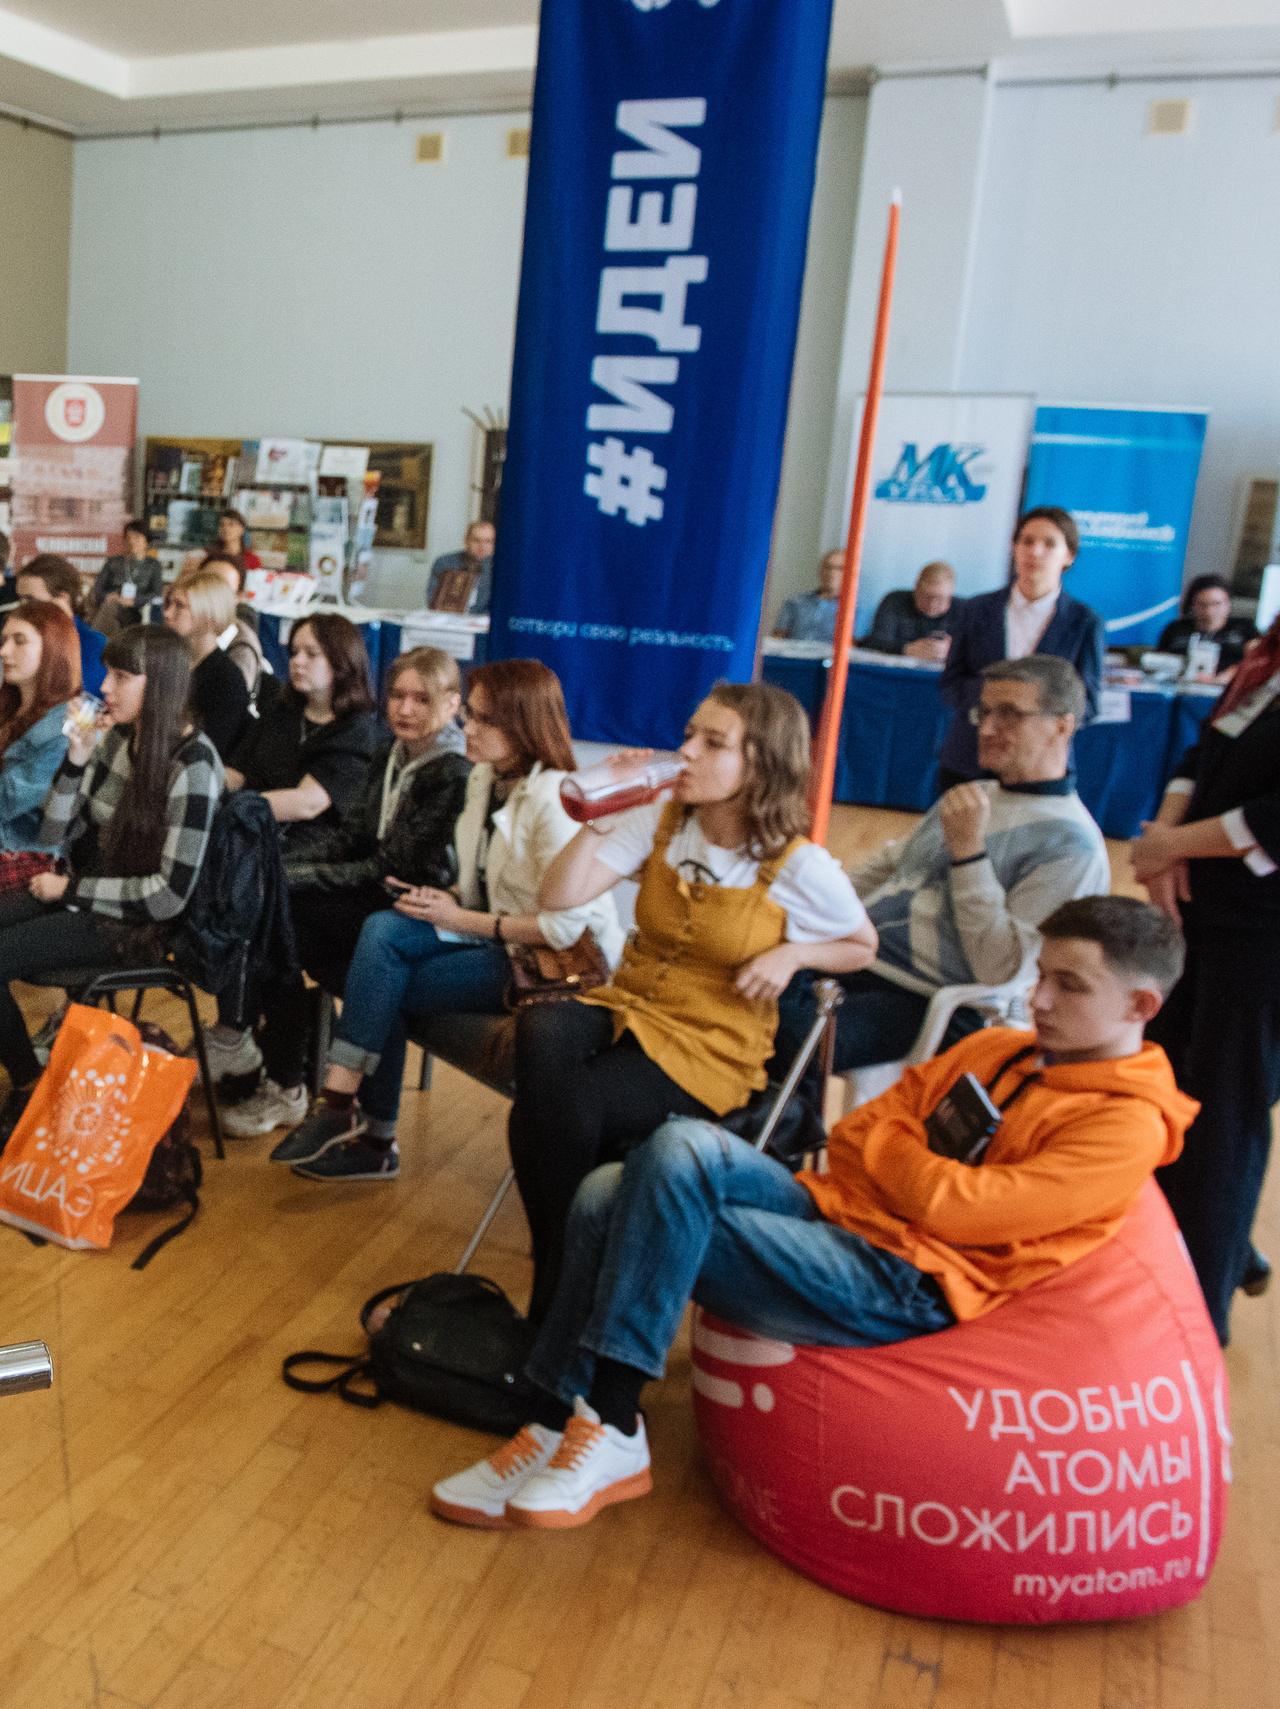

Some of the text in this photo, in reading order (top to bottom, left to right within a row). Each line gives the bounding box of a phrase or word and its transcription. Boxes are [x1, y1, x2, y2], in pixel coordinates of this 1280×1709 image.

[583, 97, 709, 527] #ИДЕИ
[579, 623, 628, 641] свою
[628, 627, 736, 652] реальность
[948, 1376, 1183, 1442] УДОБНО
[1004, 1436, 1193, 1496] АТОМЫ
[830, 1485, 1193, 1555] СЛОЖИЛИСЬ
[1013, 1556, 1193, 1604] myatom.ru
